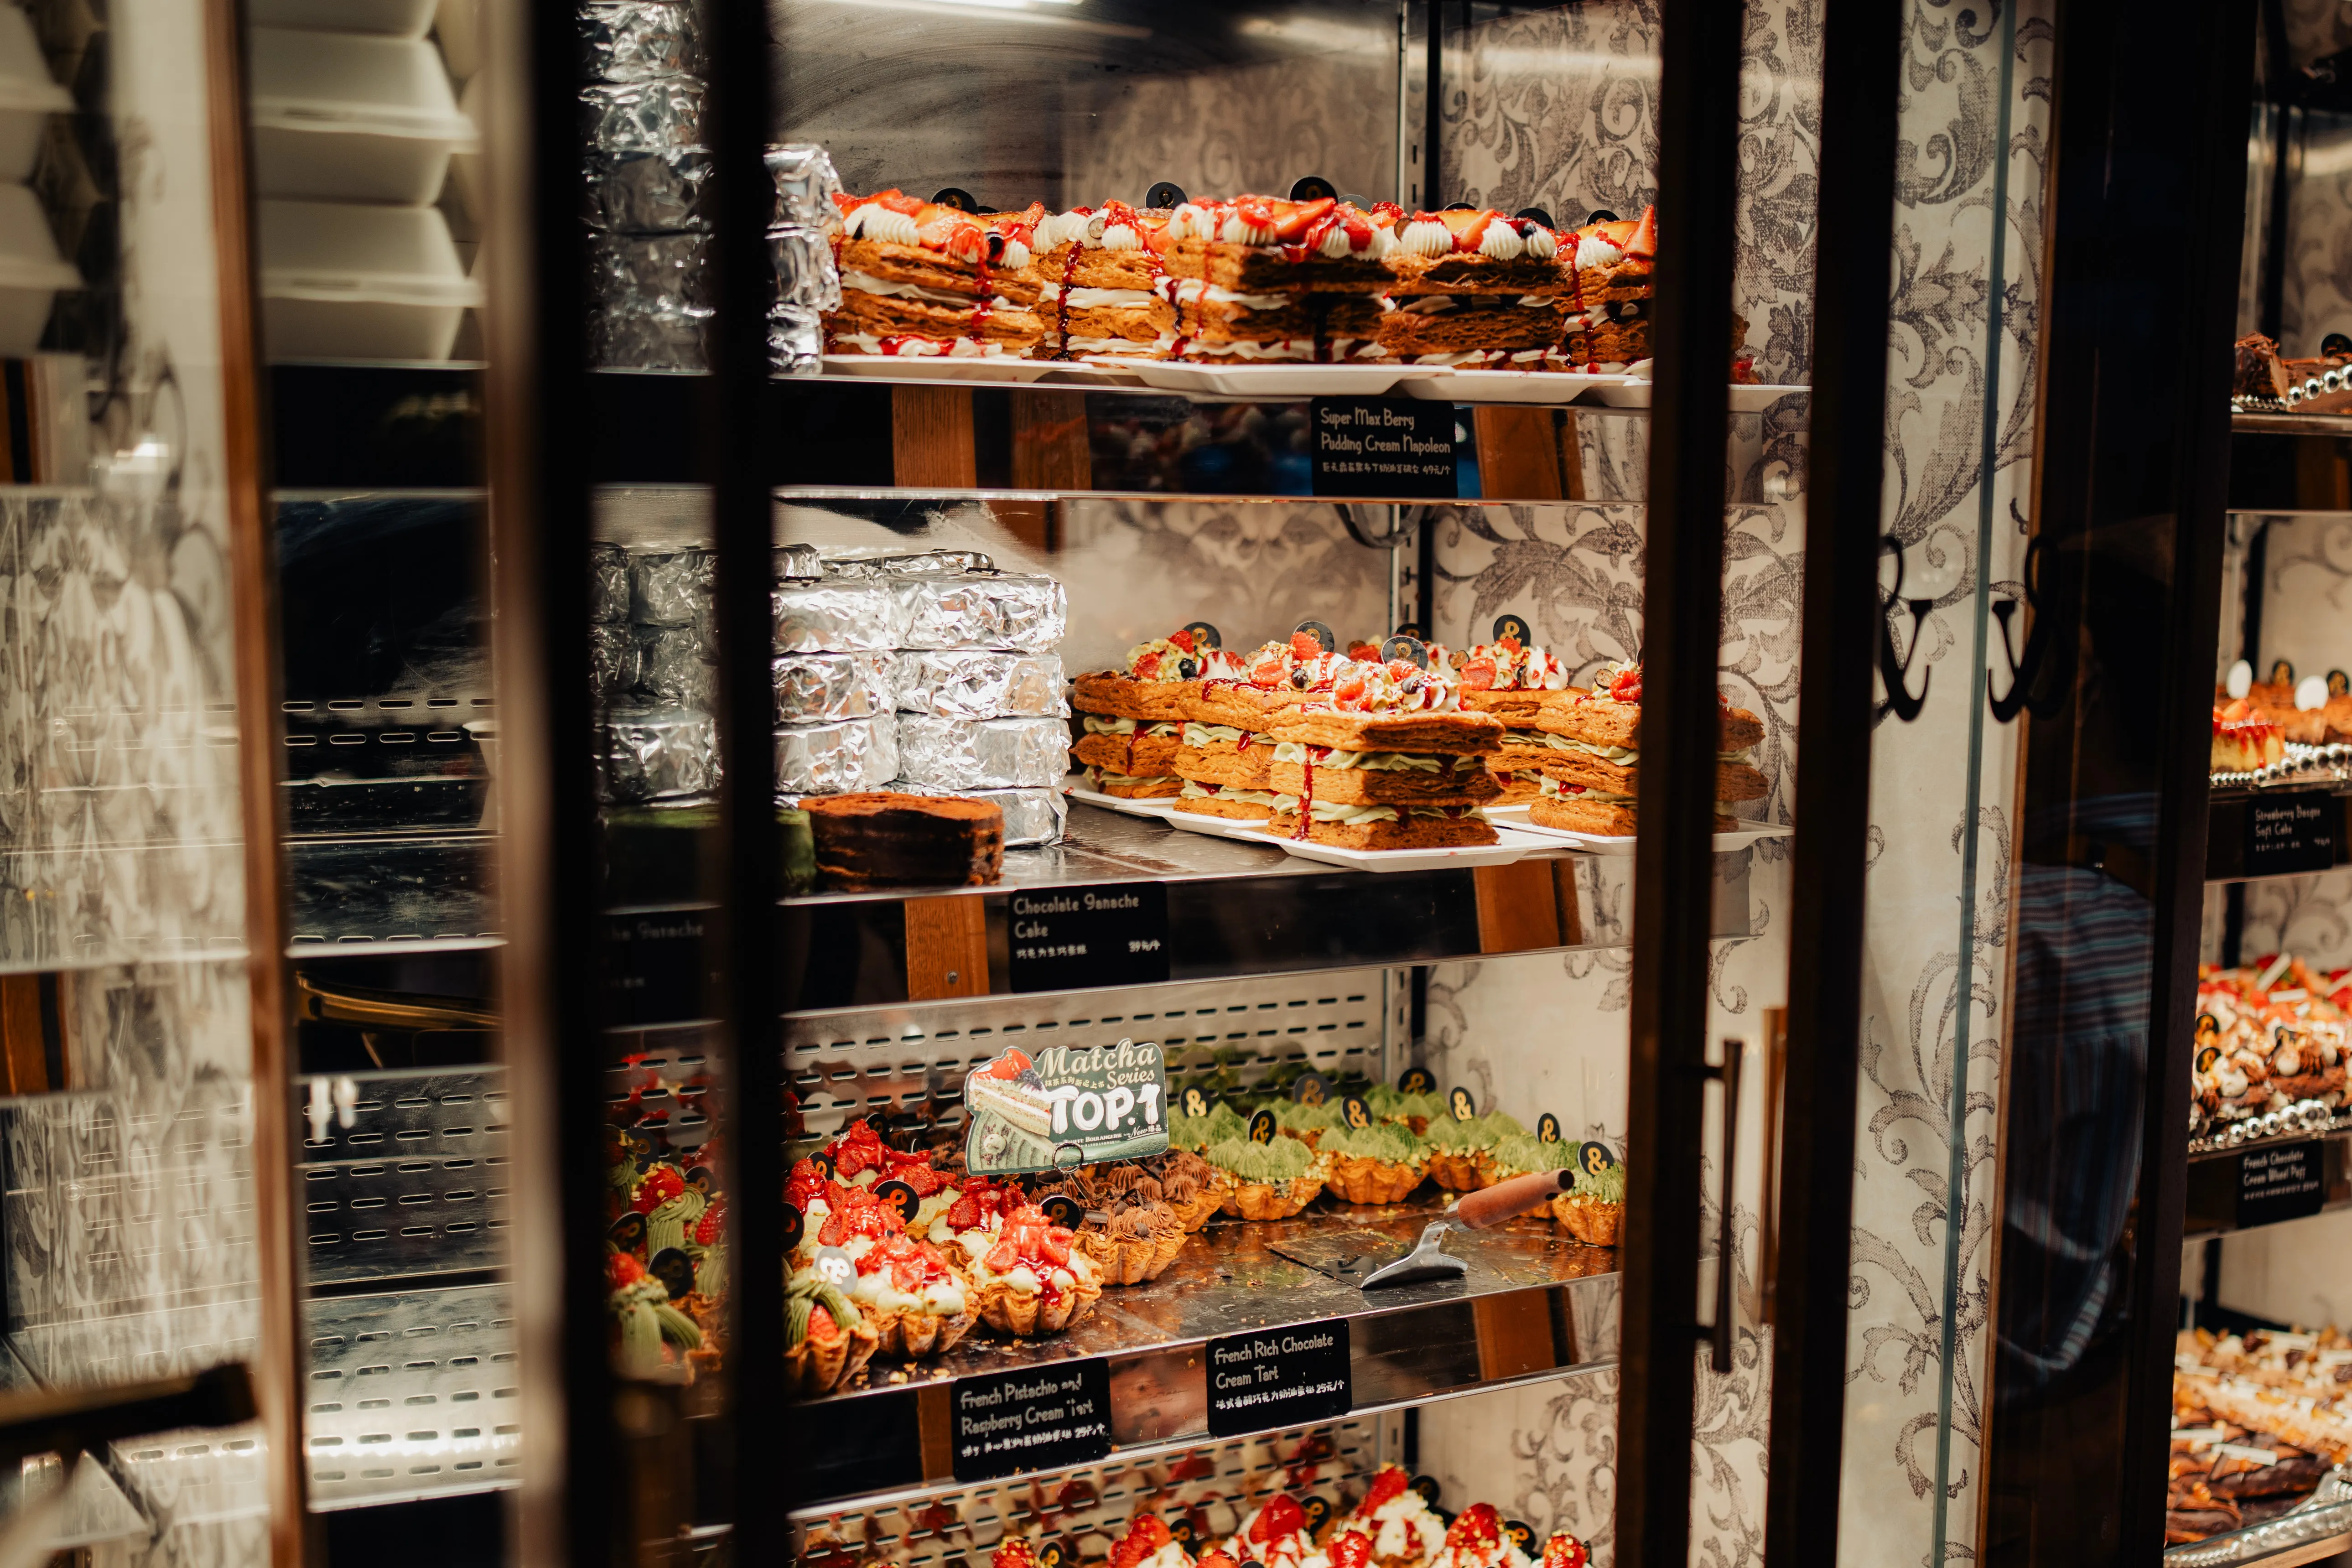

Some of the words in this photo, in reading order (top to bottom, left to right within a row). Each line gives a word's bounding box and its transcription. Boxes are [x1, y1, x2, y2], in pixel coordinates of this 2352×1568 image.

[1320, 407, 1351, 430] Super
[1355, 407, 1381, 426] Max
[1384, 408, 1414, 431] Berry
[1321, 431, 1362, 455] Pudding
[1365, 434, 1400, 452] Cream
[1403, 434, 1450, 456] Napoleon
[1013, 895, 1080, 915] Chocolate
[1083, 892, 1139, 910] Ganache
[1014, 920, 1049, 939] Cake
[1037, 1039, 1156, 1078] Matcha
[1044, 1076, 1105, 1090] 抹茶系列新品上市
[1106, 1067, 1155, 1090] Series
[1048, 1084, 1161, 1135] TOP.1
[1215, 1344, 1252, 1365] French
[1255, 1340, 1279, 1359] Rich
[1282, 1333, 1334, 1354] Chocolate
[1216, 1372, 1251, 1390] Cream
[1254, 1364, 1279, 1383] Tart
[1316, 1379, 1345, 1394] 25元/个
[960, 1387, 1002, 1410] French
[1005, 1379, 1058, 1402] Pistachio
[961, 1413, 1022, 1438] Raspberry
[1025, 1407, 1064, 1424] Cream
